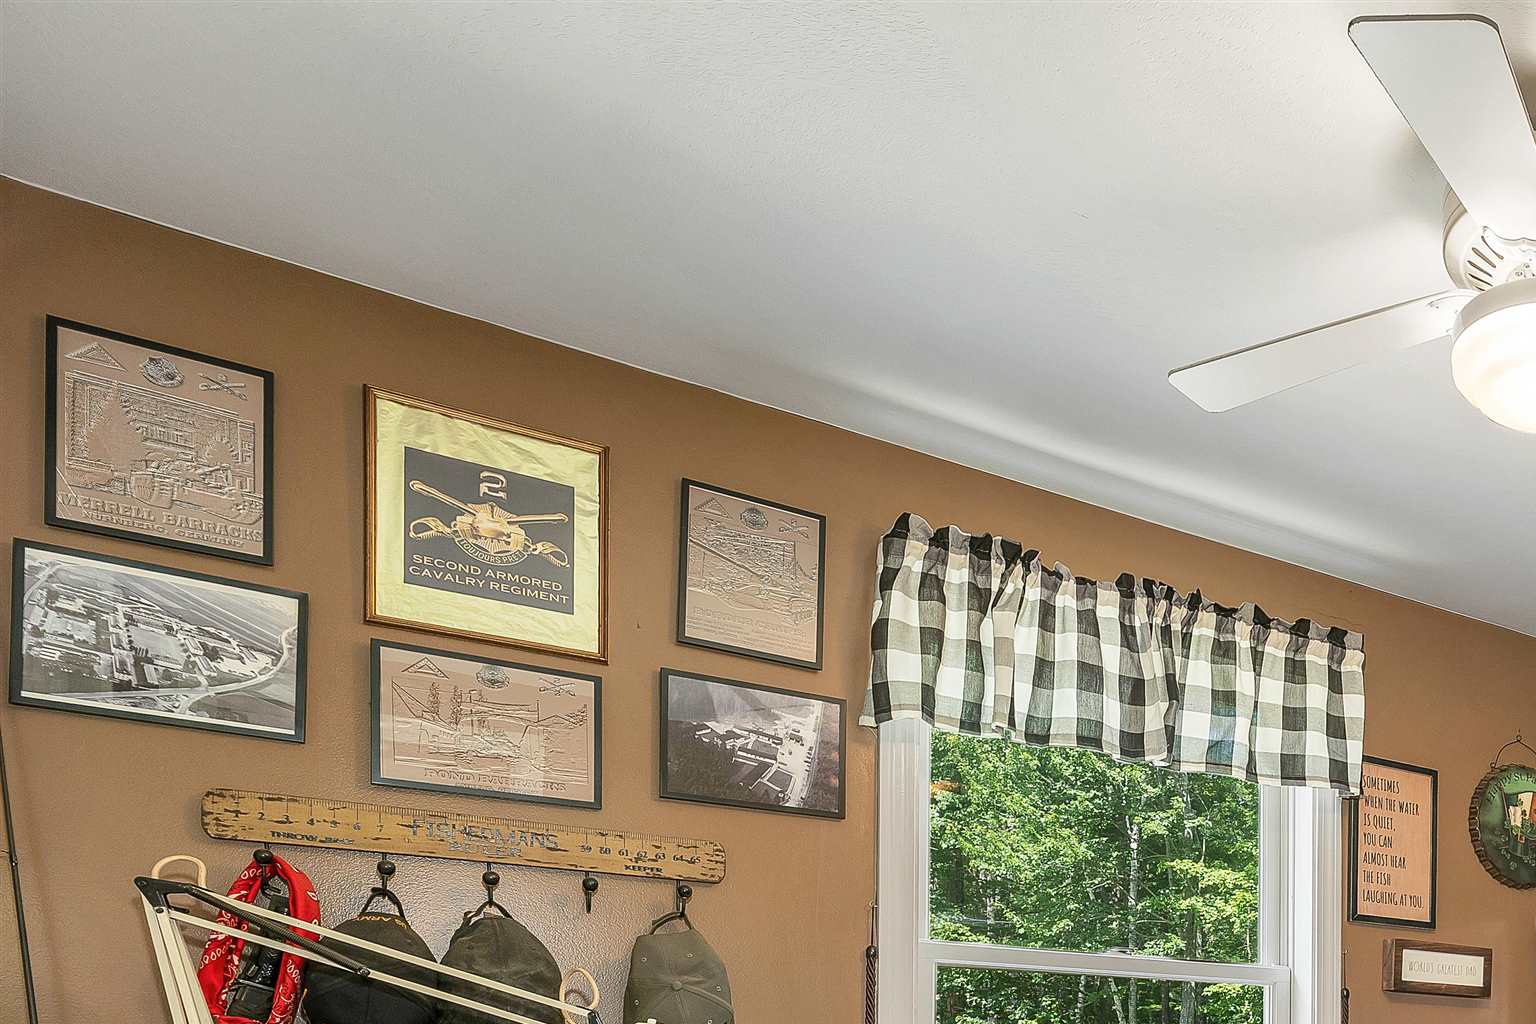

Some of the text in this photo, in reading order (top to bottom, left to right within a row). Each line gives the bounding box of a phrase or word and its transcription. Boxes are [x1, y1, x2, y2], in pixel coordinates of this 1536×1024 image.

[479, 470, 508, 500] 2
[163, 511, 263, 543] BARRACKS
[412, 554, 563, 592] SECOND ARMORED
[409, 565, 569, 604] CAVALRY REGIMENT
[1362, 774, 1400, 795] SOMETIMES
[1364, 795, 1420, 817] WHEN THE WATER
[1363, 813, 1371, 827] IS
[257, 811, 265, 821] 2
[618, 848, 629, 857] 61
[636, 850, 648, 859] 62
[1363, 832, 1393, 849] YOU CAN
[624, 864, 664, 874] KEEPER
[1363, 852, 1407, 870] ALMOST HEAR
[1363, 869, 1392, 887] THE FISH
[1362, 889, 1424, 909] LAUGHING AT YOU.
